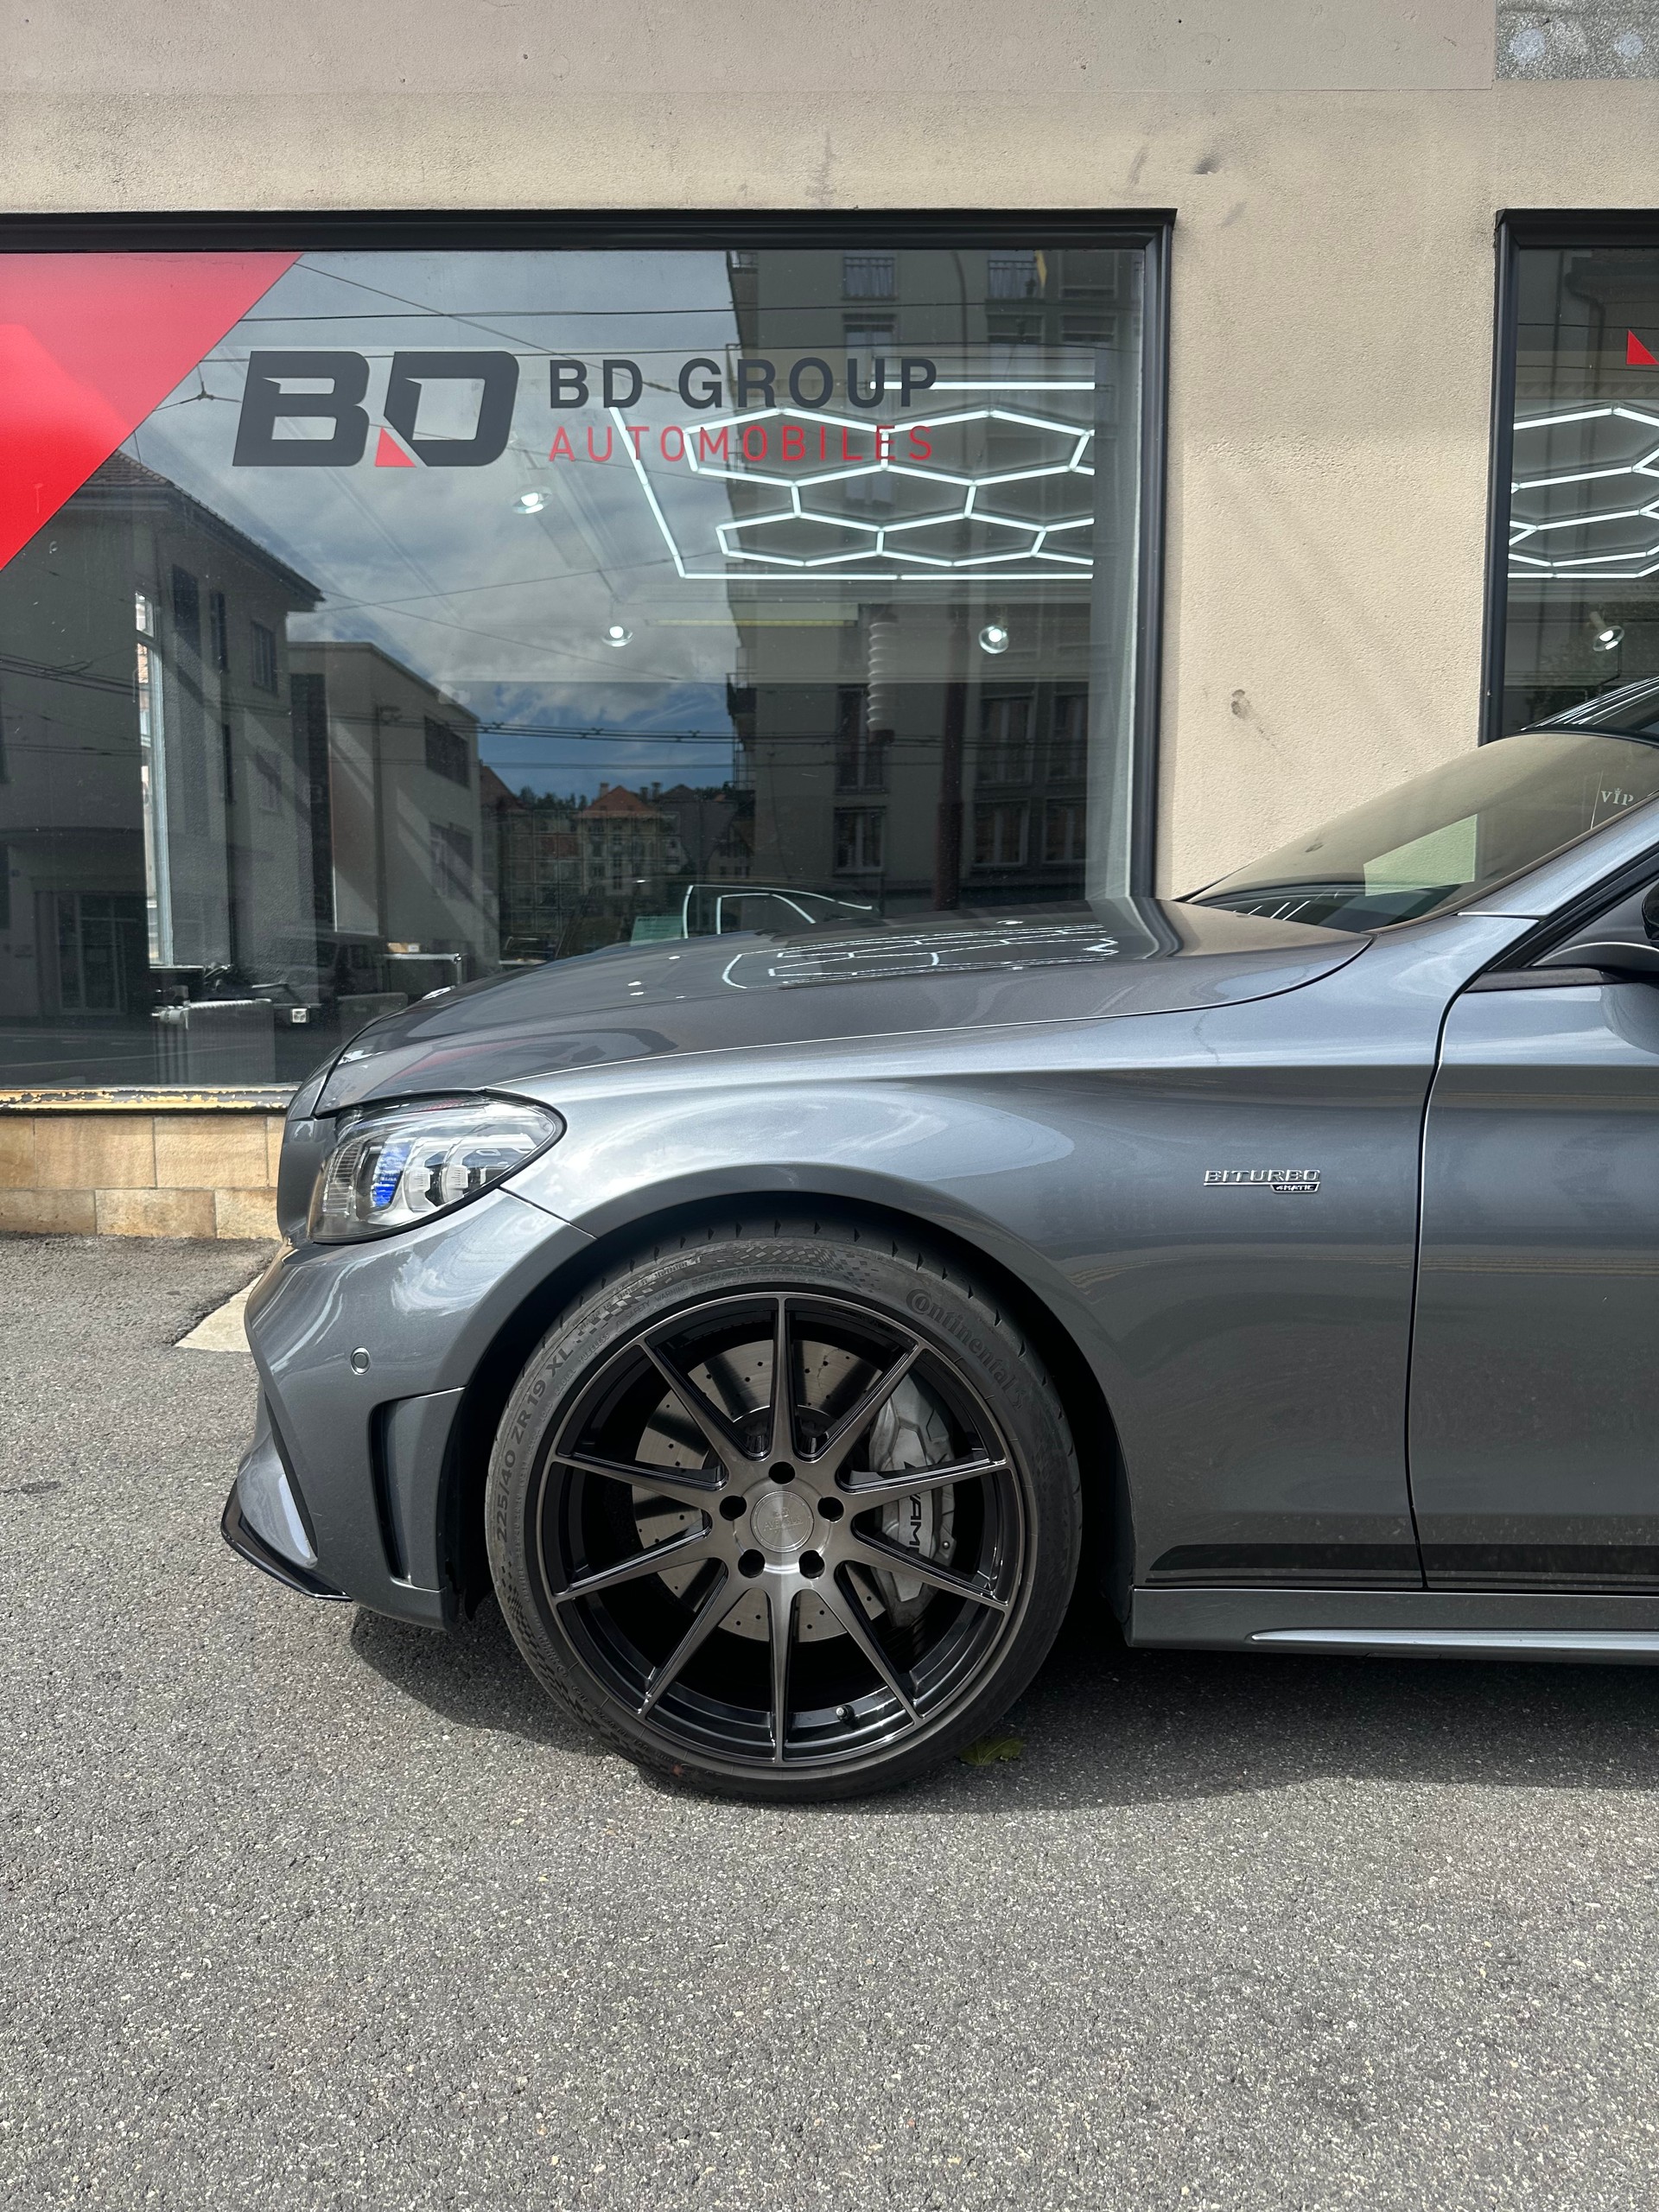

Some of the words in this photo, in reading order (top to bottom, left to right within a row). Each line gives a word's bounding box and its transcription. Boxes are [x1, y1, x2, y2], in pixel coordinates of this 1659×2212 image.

[550, 358, 644, 410] BD
[678, 358, 938, 410] GROUP
[232, 350, 520, 467] BD
[548, 424, 934, 462] AUTOMOBILES
[1600, 788, 1634, 806] VIP
[1204, 1169, 1320, 1183] BITURBO
[654, 1283, 689, 1302] WARNING
[577, 1332, 611, 1364] TUBELESS
[906, 1288, 1016, 1391] Continental
[496, 1450, 517, 1543] 225/40
[510, 1409, 531, 1442] ZR
[527, 1379, 547, 1407] 19
[545, 1348, 574, 1378] XL
[909, 1494, 922, 1553] AM
